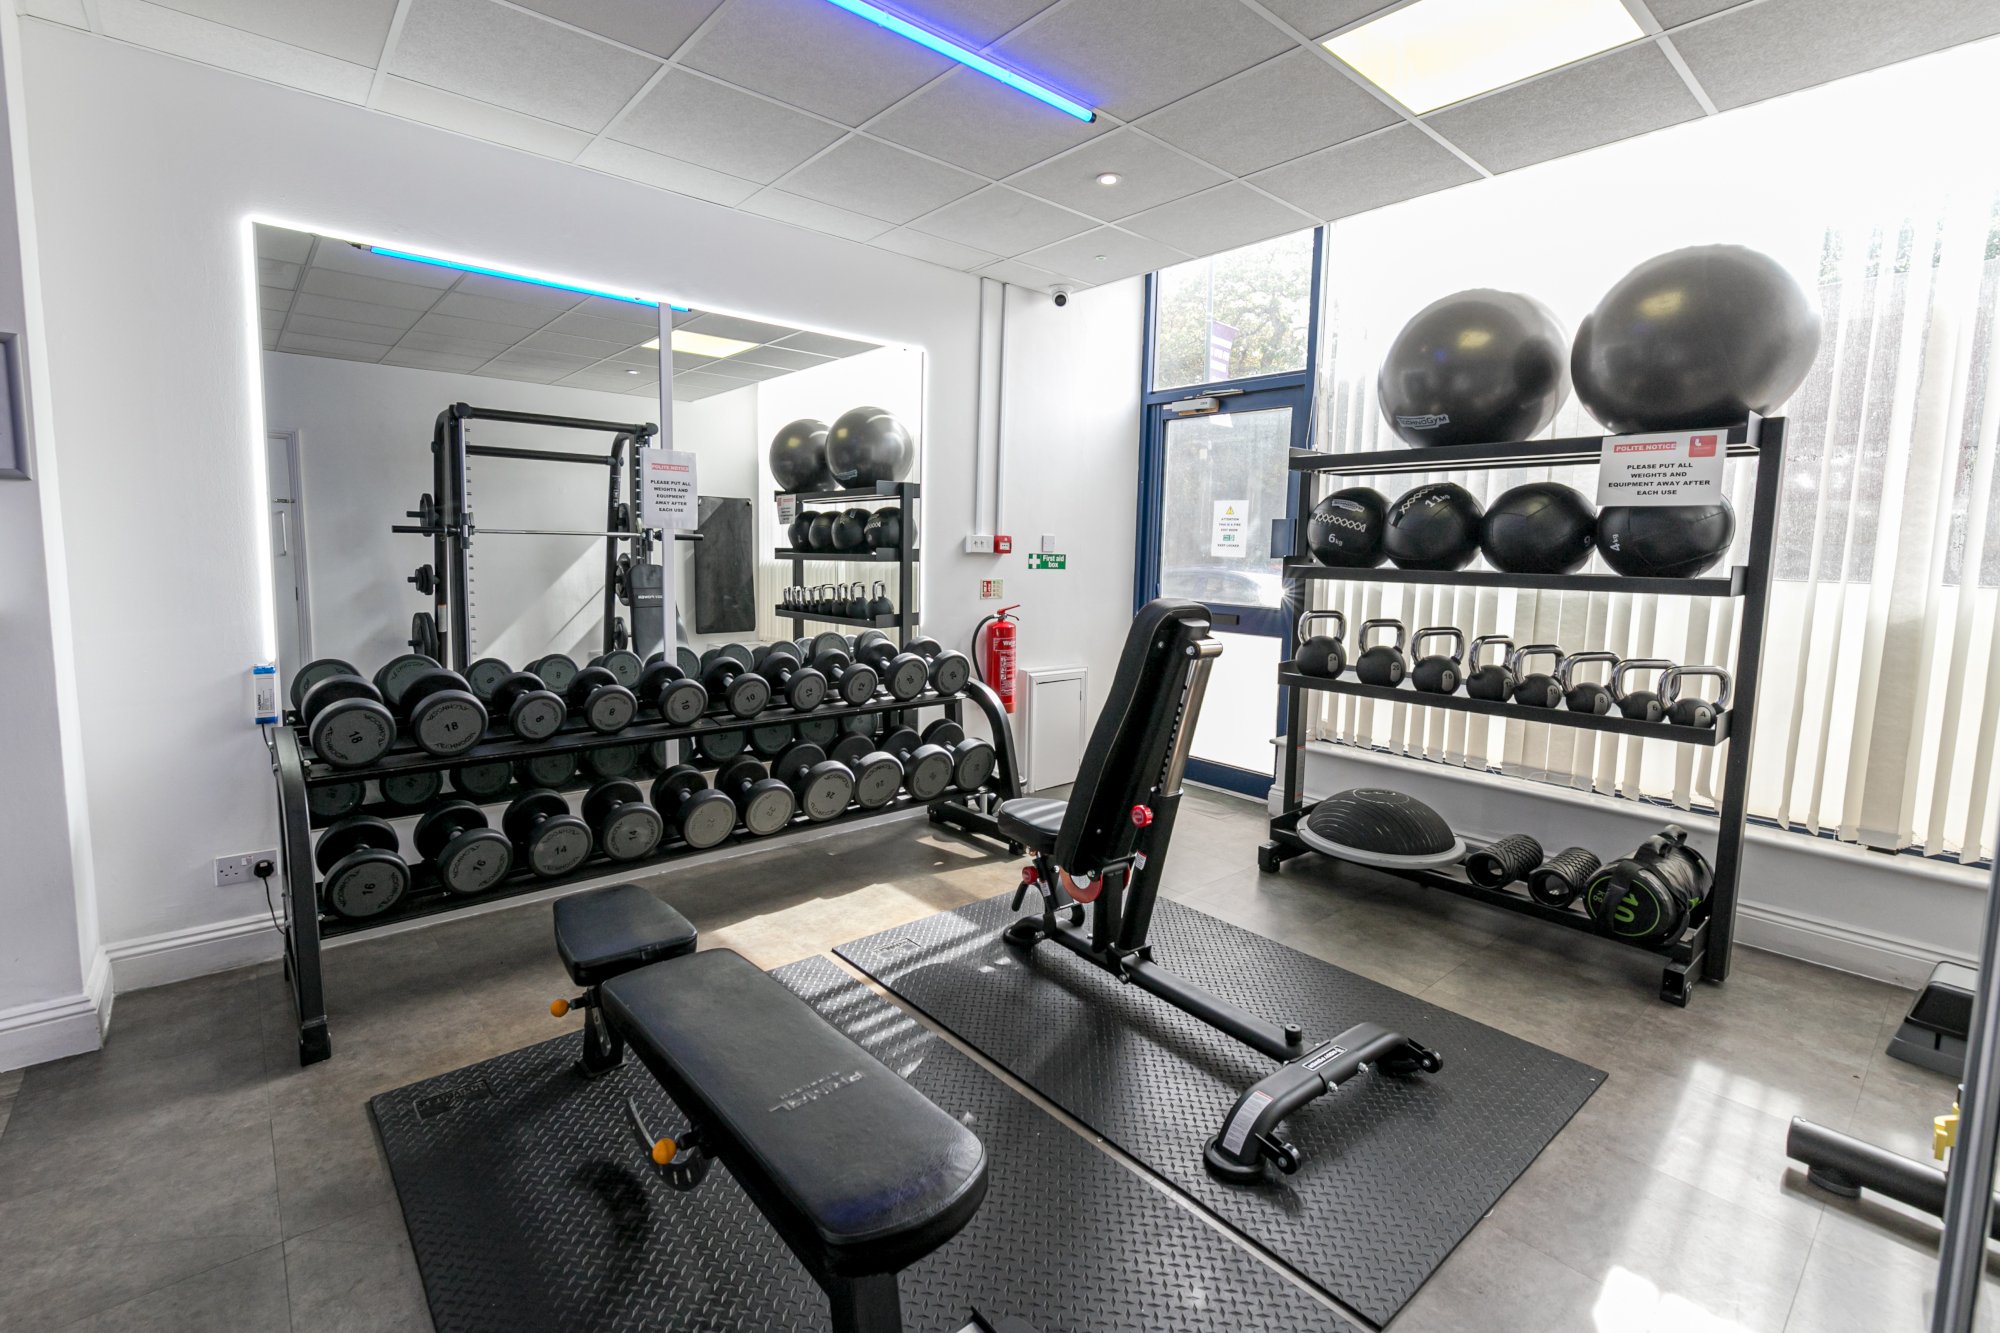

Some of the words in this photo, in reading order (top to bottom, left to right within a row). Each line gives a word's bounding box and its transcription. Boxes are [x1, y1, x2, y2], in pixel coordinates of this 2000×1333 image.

[1328, 533, 1344, 547] 6kg
[1043, 554, 1055, 562] First
[1055, 554, 1064, 562] aid
[443, 721, 459, 732] 18
[348, 730, 363, 744] 18
[553, 845, 567, 855] 14
[472, 859, 487, 872] 16
[362, 882, 376, 896] 16
